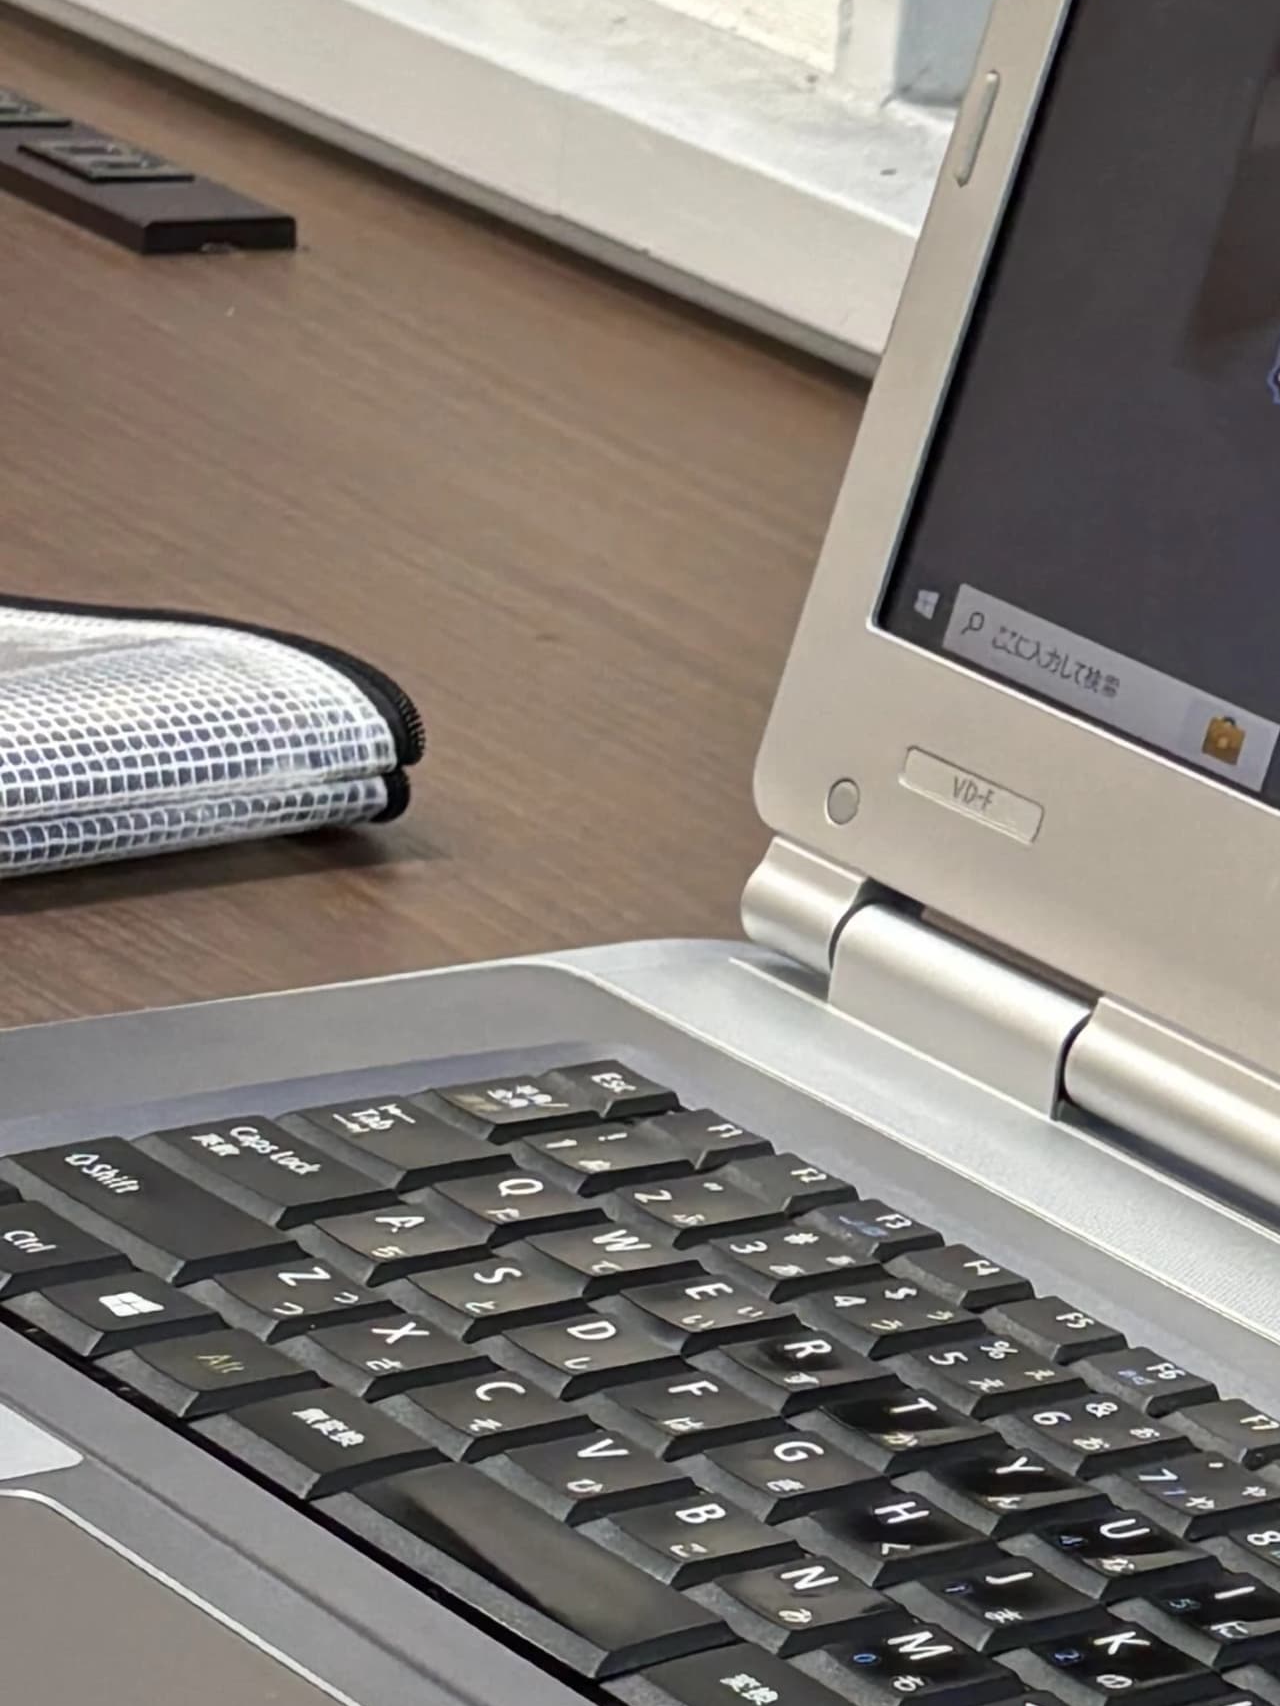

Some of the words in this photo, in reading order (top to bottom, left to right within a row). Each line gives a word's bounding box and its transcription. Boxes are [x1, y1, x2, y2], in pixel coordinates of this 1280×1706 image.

[590, 1071, 636, 1092] Esc
[707, 1122, 743, 1139] F1
[229, 1125, 275, 1158] Caps
[87, 1160, 141, 1195] Shift
[498, 1178, 542, 1196] Q
[634, 1190, 672, 1204] 2
[375, 1215, 425, 1233] A
[876, 1213, 913, 1230] F3
[3, 1228, 57, 1254] Ctrl
[592, 1228, 651, 1254] W
[730, 1240, 767, 1254] 3
[278, 1267, 331, 1288] Z
[473, 1266, 522, 1285] S
[685, 1282, 733, 1303] E
[834, 1294, 865, 1308] 4
[566, 1321, 617, 1341] D
[1055, 1311, 1095, 1331] F5
[372, 1321, 429, 1344] X
[784, 1338, 833, 1360] R
[929, 1350, 967, 1366] 5
[196, 1352, 243, 1374] Alt
[1148, 1362, 1187, 1382] F6
[475, 1380, 526, 1401] C
[668, 1380, 719, 1400] F
[891, 1396, 938, 1418] T
[1031, 1408, 1071, 1427] 6
[1239, 1414, 1280, 1434] F7
[577, 1438, 630, 1464] V
[772, 1439, 824, 1462] G
[995, 1456, 1044, 1480] Y
[675, 1503, 725, 1526] B
[873, 1500, 930, 1525] H
[1099, 1518, 1151, 1541] U
[780, 1565, 841, 1591] N
[985, 1571, 1033, 1585] J
[887, 1631, 953, 1659] M
[1093, 1632, 1149, 1655] K
